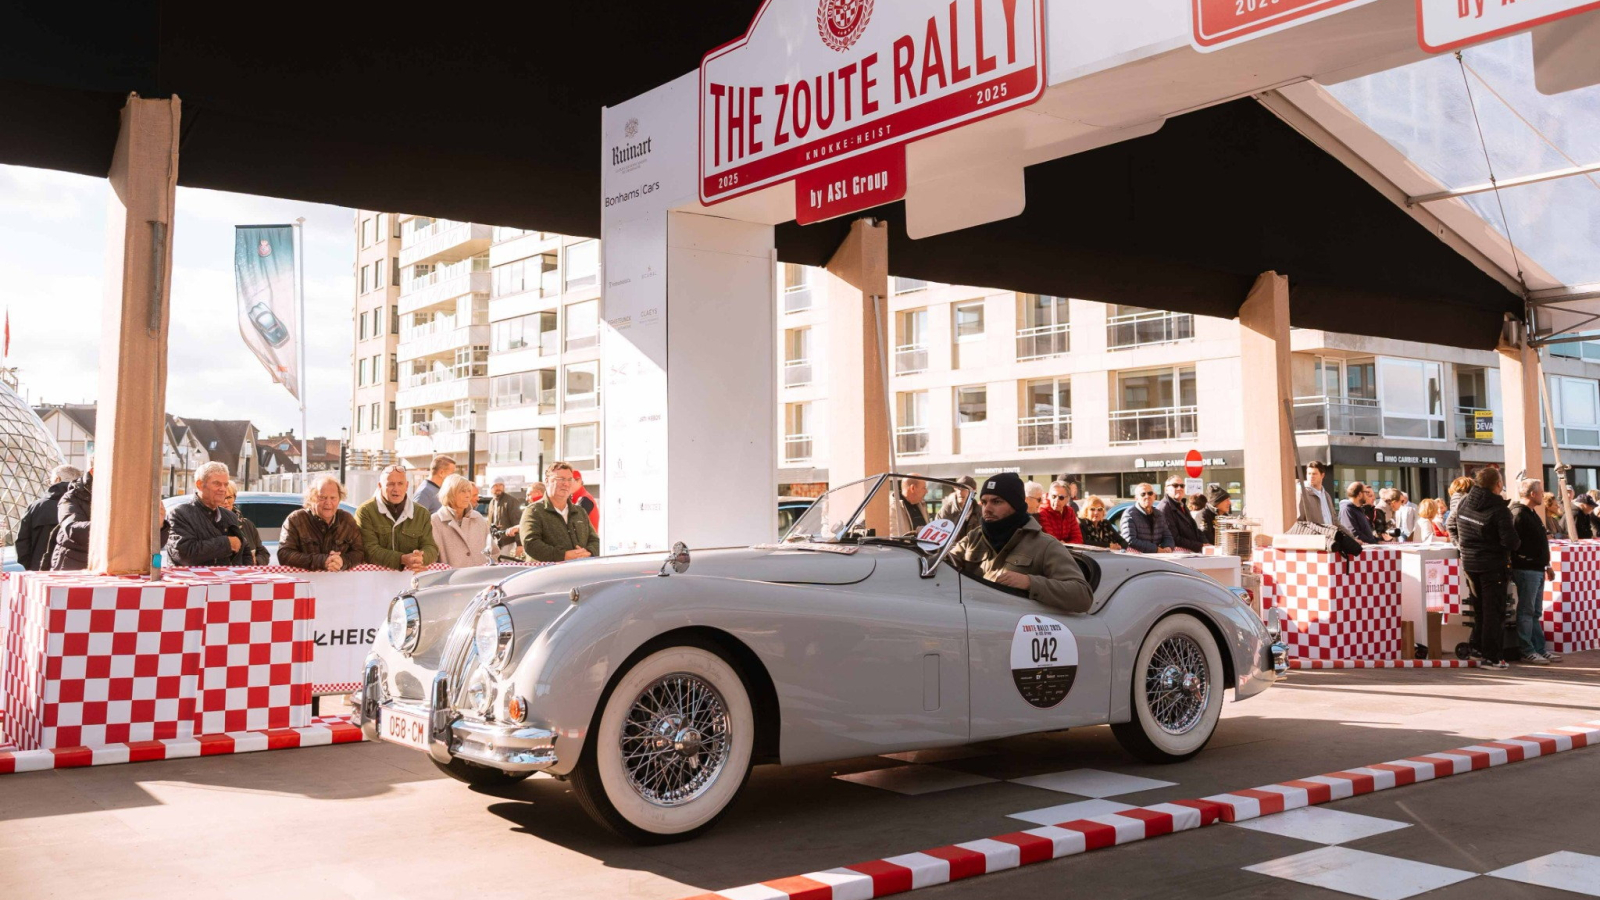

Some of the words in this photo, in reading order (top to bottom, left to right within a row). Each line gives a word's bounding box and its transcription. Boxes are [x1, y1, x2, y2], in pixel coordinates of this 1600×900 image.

[710, 83, 763, 167] THE
[774, 52, 878, 146] ZOUTE
[893, 0, 1017, 105] RALLY
[977, 82, 1007, 104] 2025
[612, 136, 652, 166] Ruinart
[718, 173, 738, 189] 2025
[810, 190, 822, 208] by
[827, 180, 848, 203] ASL
[852, 171, 888, 195] Group
[605, 189, 640, 207] Bonhams
[642, 181, 659, 195] Cars
[1146, 460, 1164, 468] IMMO
[921, 528, 948, 543] 042
[330, 628, 380, 645] HEIS
[1031, 637, 1058, 663] 042
